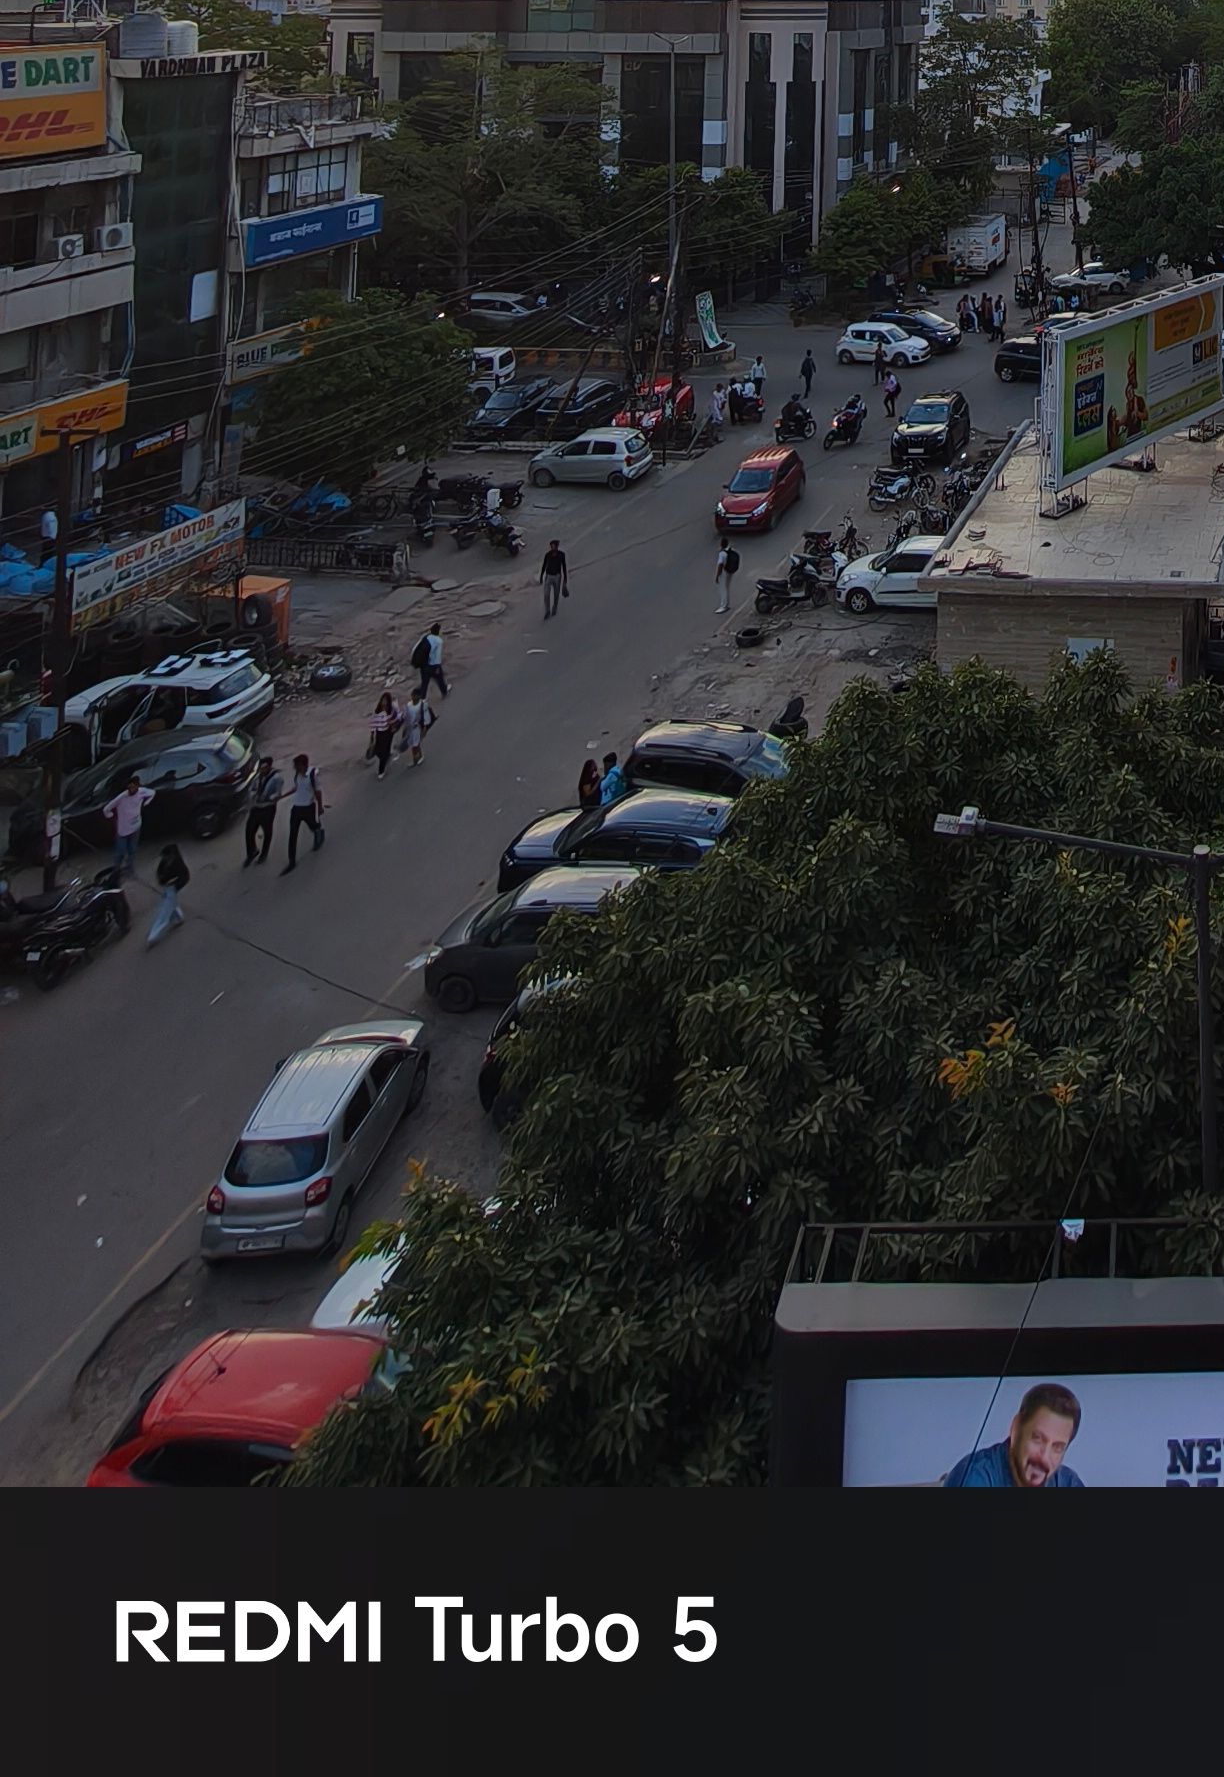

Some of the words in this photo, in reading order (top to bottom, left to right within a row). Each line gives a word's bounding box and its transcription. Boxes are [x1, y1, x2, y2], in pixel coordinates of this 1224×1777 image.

[24, 55, 95, 88] DART
[221, 52, 266, 72] PLAZA
[115, 543, 148, 571] NEW
[170, 514, 215, 545] MOTOR
